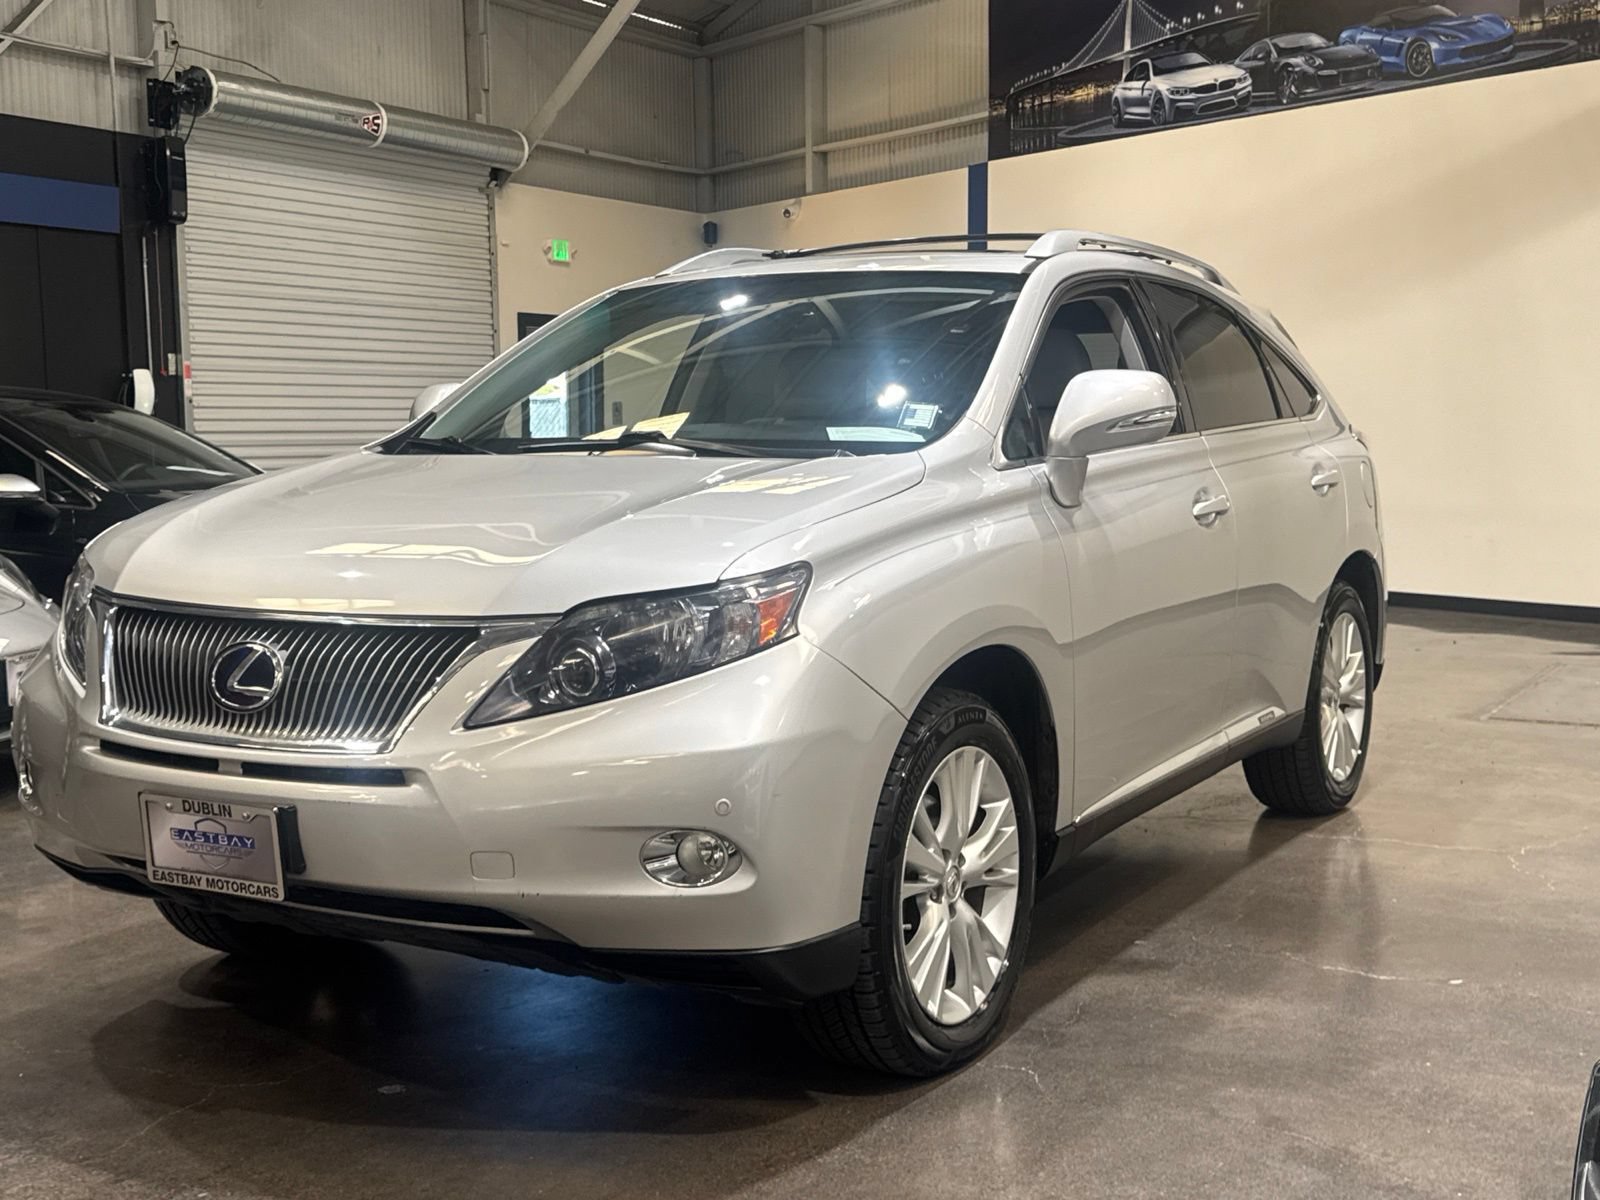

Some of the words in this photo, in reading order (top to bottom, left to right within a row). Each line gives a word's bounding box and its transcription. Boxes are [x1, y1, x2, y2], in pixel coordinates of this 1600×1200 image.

[182, 800, 232, 818] DUBLIN
[171, 828, 254, 848] EASTBAY
[152, 870, 202, 886] EASTBAY
[206, 877, 280, 899] MOTORCARS
